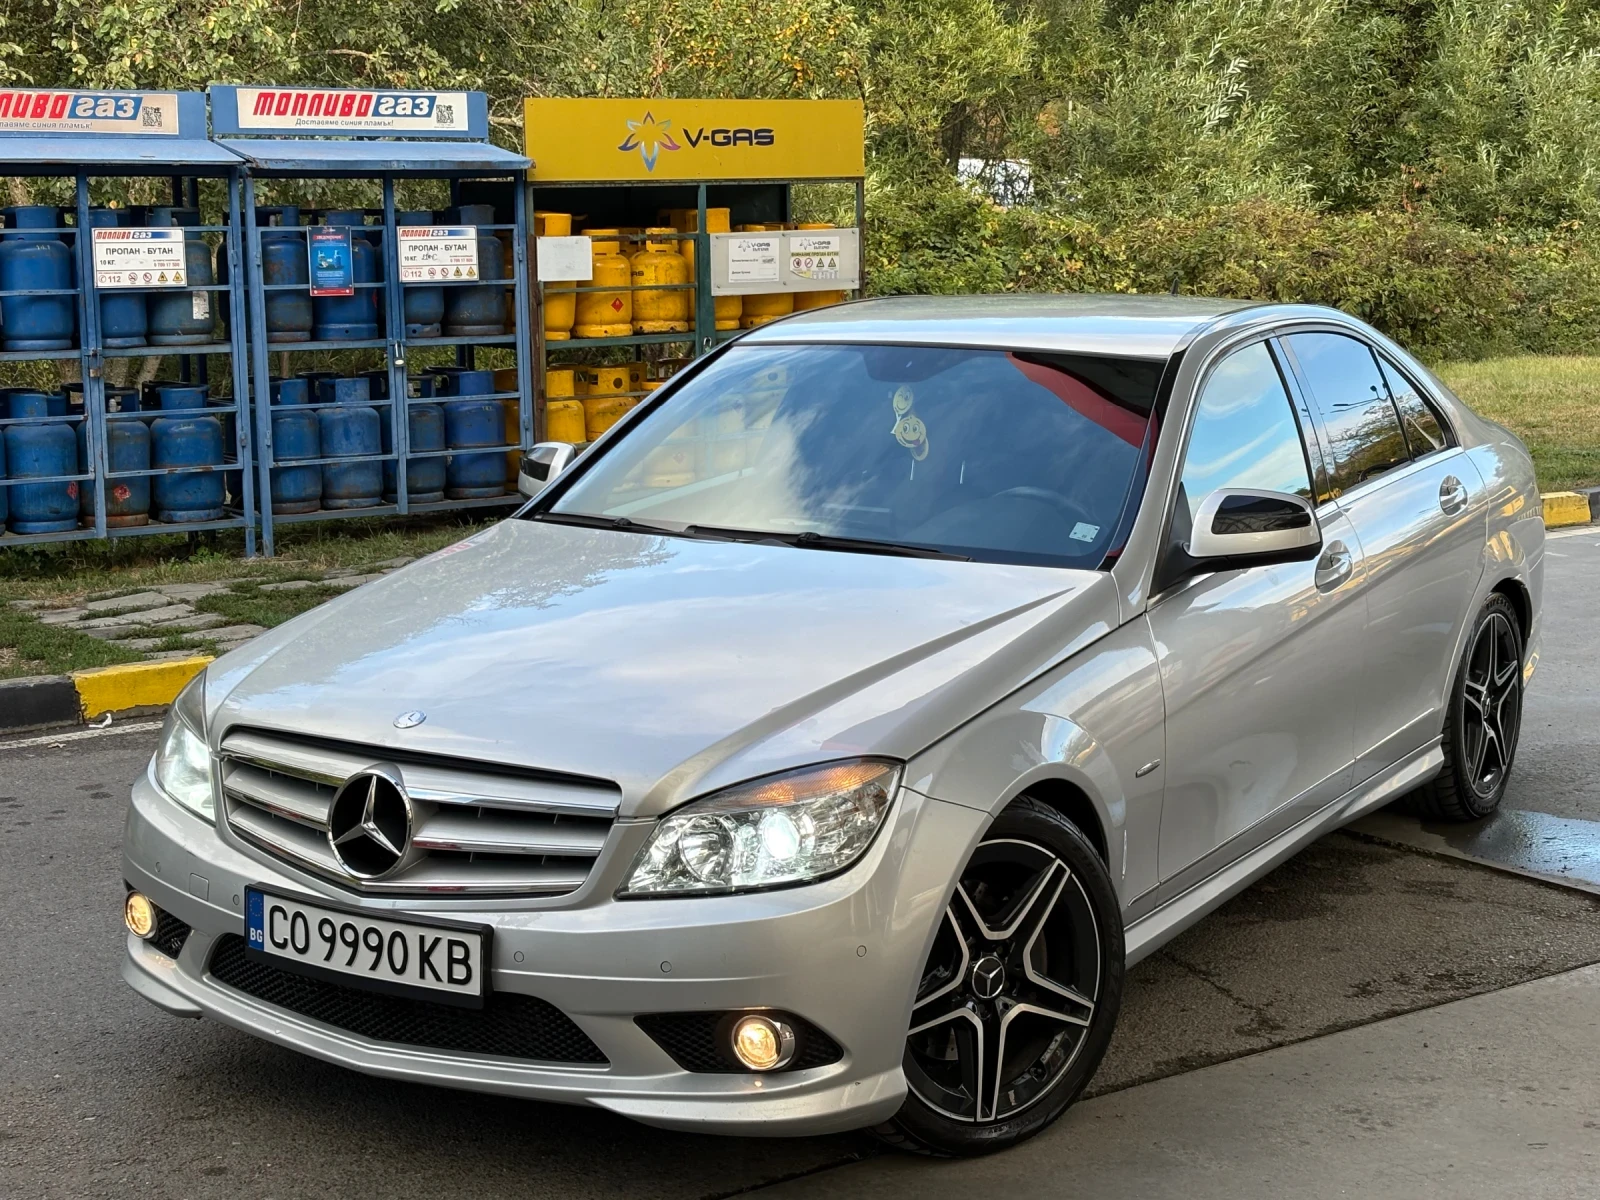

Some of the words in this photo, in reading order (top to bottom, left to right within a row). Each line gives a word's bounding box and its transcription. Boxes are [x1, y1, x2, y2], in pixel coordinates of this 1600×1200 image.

[295, 118, 340, 127] Доставяме
[683, 127, 775, 148] V-GAS
[147, 247, 173, 255] БУТАН
[249, 926, 264, 943] BG
[317, 917, 409, 976] 9990
[418, 934, 473, 986] KB
